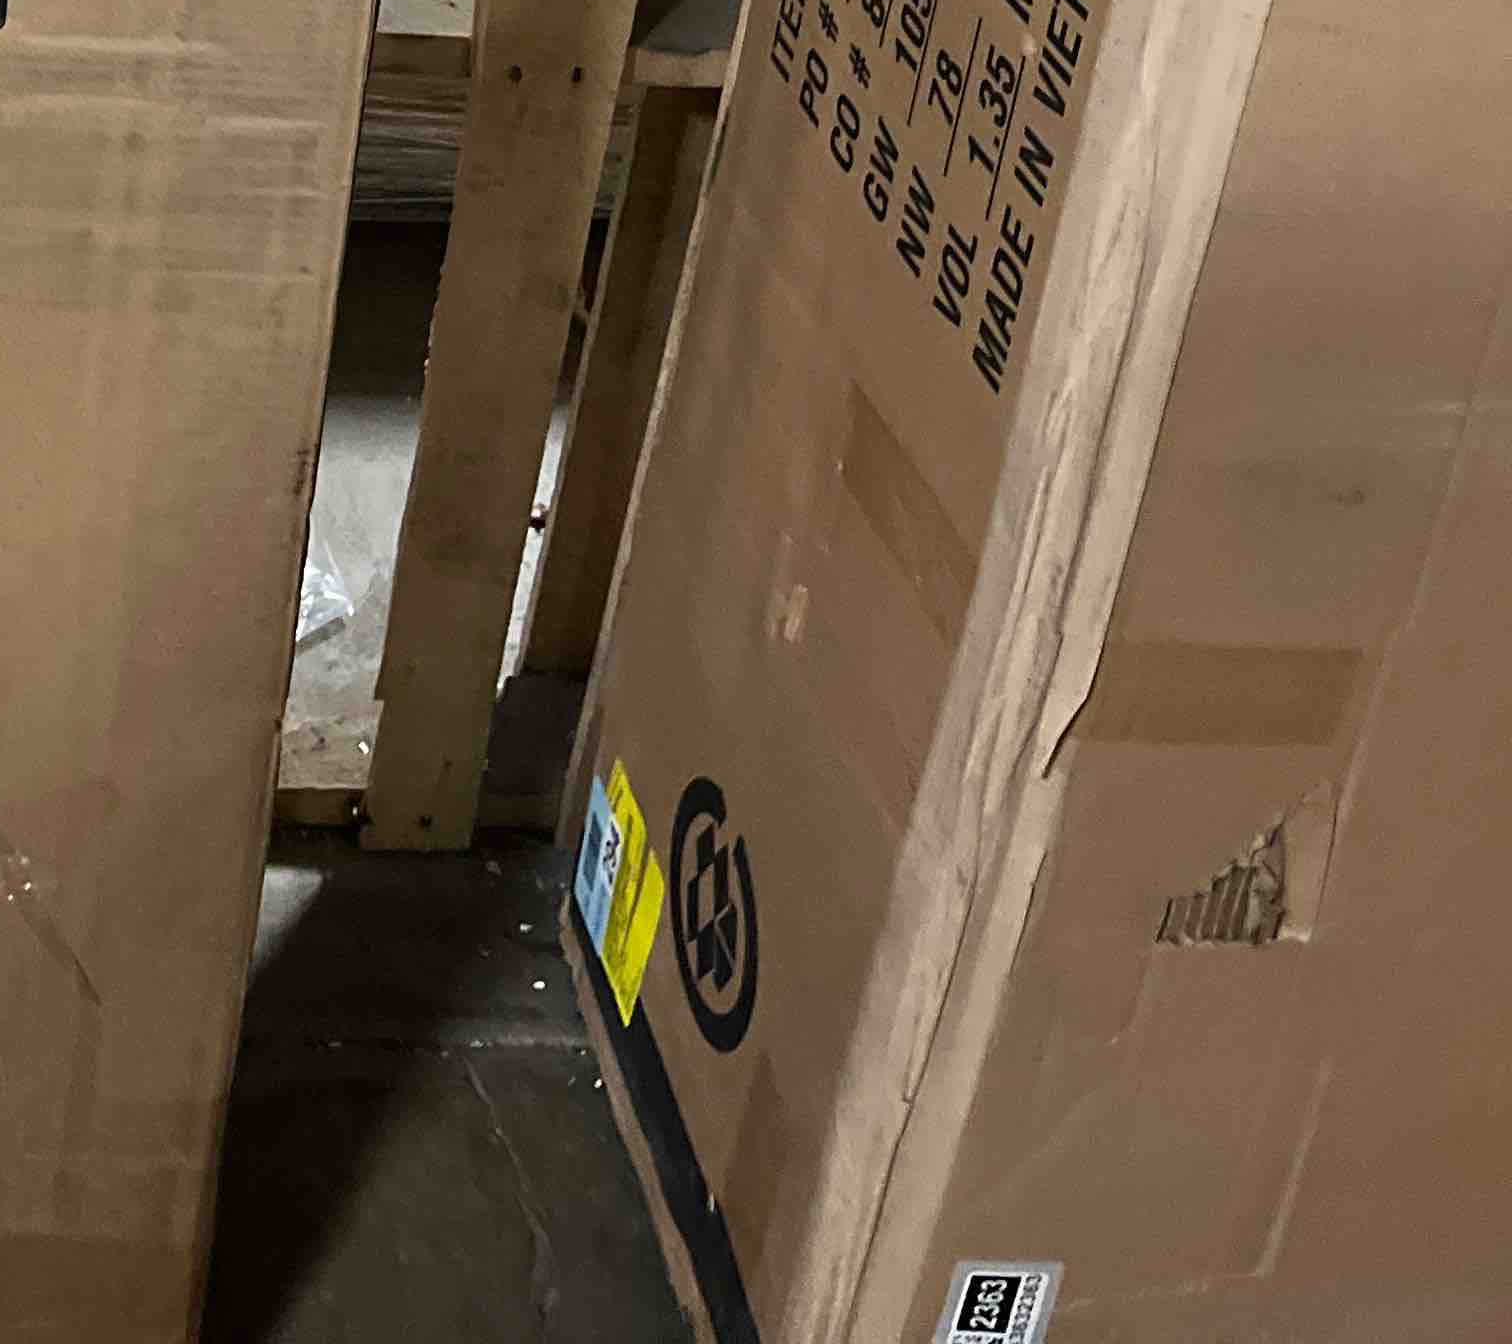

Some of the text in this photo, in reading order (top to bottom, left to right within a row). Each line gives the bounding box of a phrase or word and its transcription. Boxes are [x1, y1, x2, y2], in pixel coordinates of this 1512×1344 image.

[799, 47, 829, 128] PO
[818, 0, 838, 43] #
[829, 93, 860, 174] CO
[849, 42, 870, 90] #
[862, 115, 899, 224] GW
[895, 165, 935, 278] NW
[928, 49, 963, 129] 78
[932, 224, 978, 329] VOL
[968, 44, 1016, 175] 1.35
[971, 204, 1034, 395] MADE
[1014, 127, 1056, 209] IN
[969, 1279, 1008, 1330] 2363
